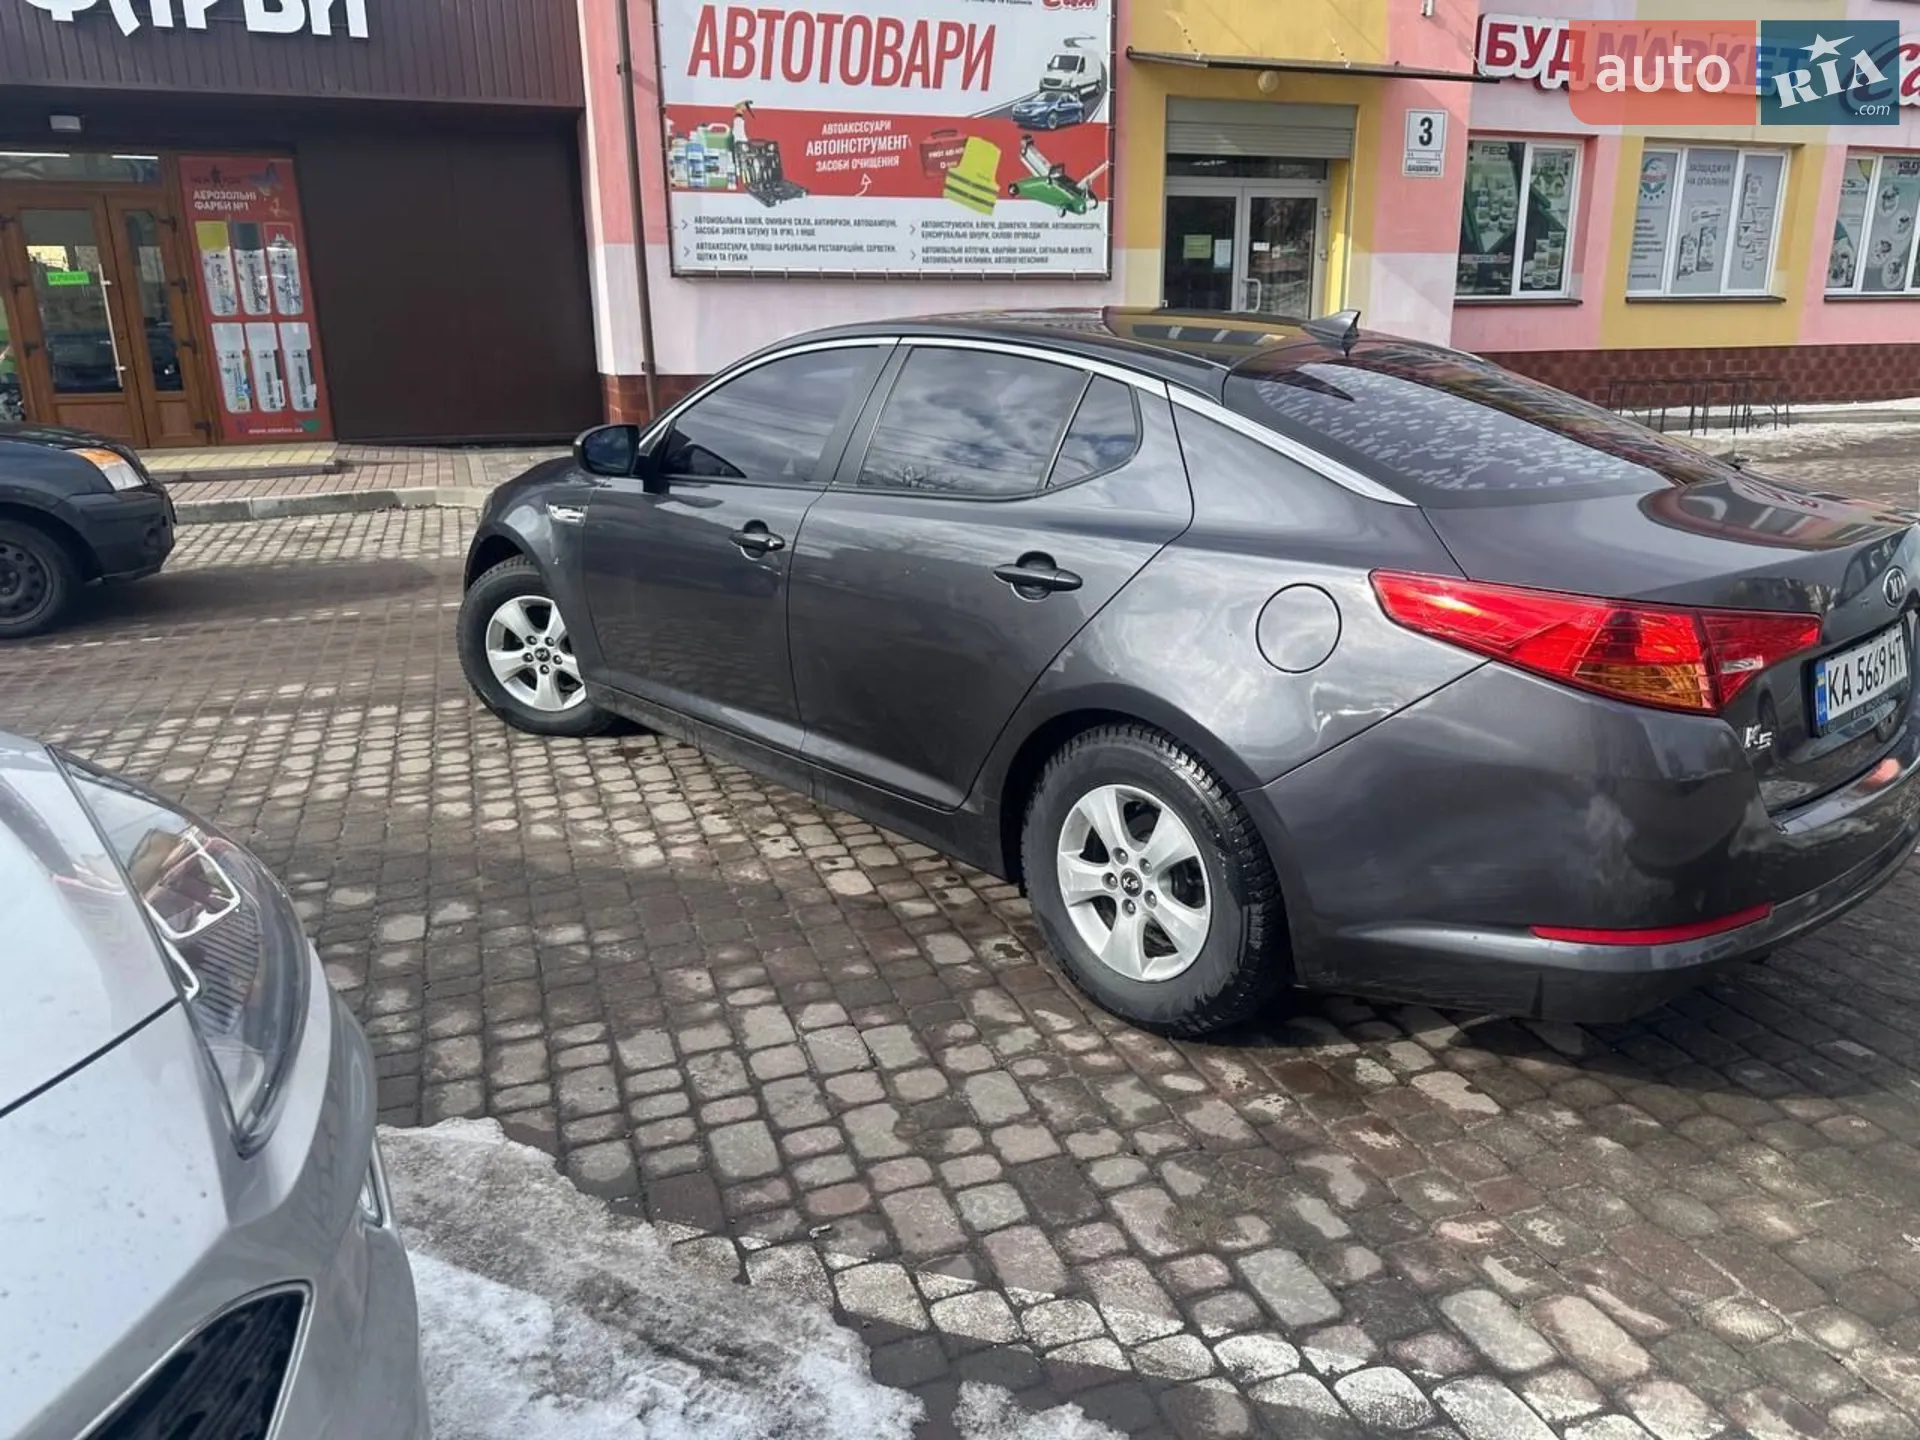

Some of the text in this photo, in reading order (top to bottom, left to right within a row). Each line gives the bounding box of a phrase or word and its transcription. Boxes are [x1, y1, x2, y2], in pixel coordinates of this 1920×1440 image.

[687, 5, 996, 92] АВТОТОВАРИ
[1485, 23, 1587, 81] БУД
[822, 120, 891, 136] АВТОАКСЕСУАРИ
[1419, 116, 1433, 147] 3
[816, 155, 900, 172] ЗАСОБИ ОЧИЩЕННЯ
[193, 190, 257, 200] АЕРОЗОЛЬНІ
[194, 201, 231, 211] ФАРБИ
[1828, 663, 1852, 710] KA
[1857, 645, 1887, 696] 5669
[1744, 724, 1772, 750] K5
